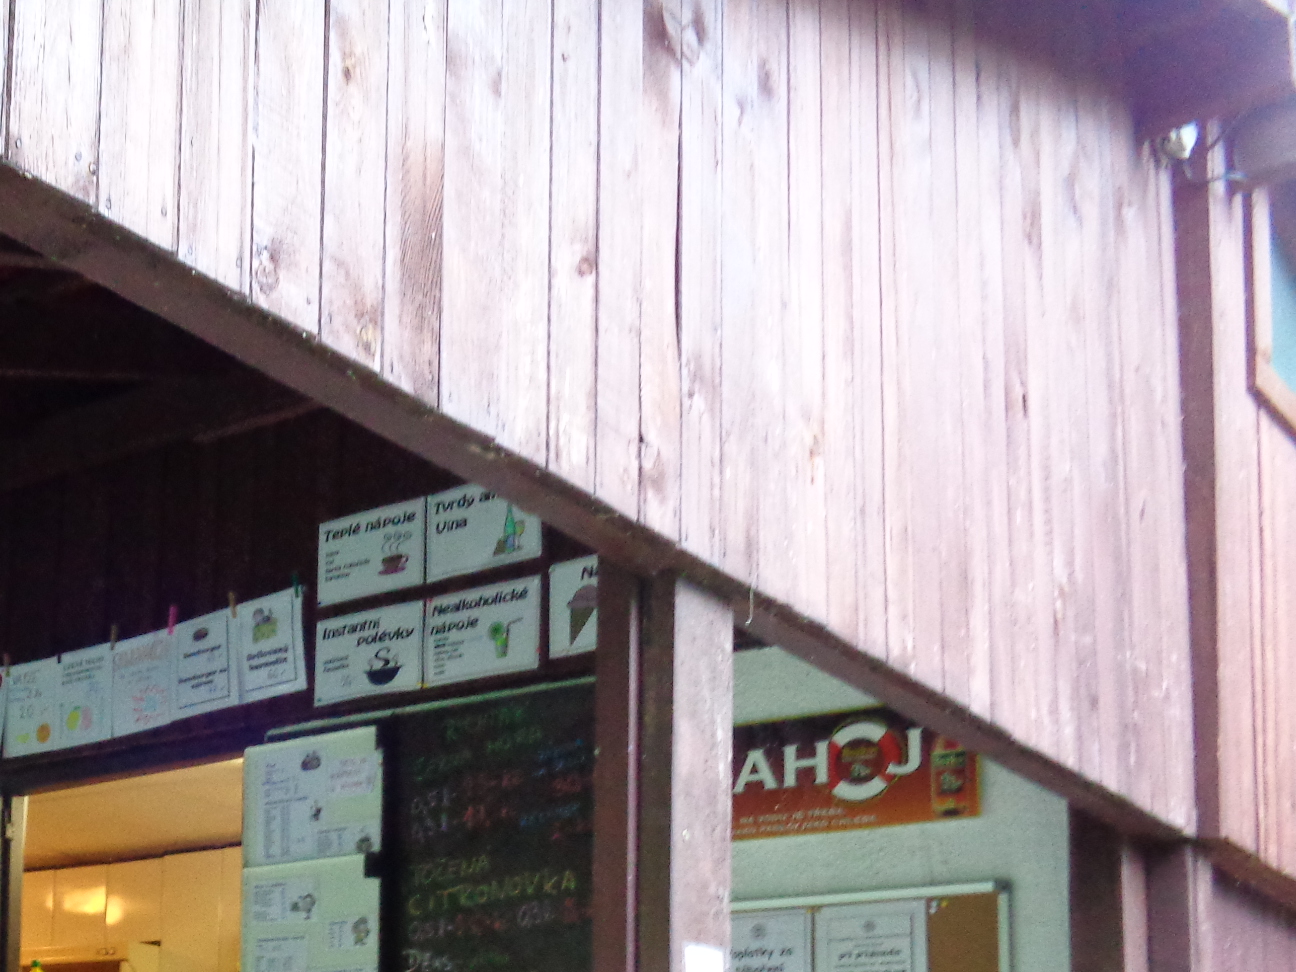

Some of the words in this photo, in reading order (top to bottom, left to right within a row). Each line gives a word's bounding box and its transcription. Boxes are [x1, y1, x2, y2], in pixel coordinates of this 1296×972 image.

[324, 522, 361, 543] Teplé
[364, 511, 417, 533] nápoje
[432, 587, 529, 617] Nealkoholické
[322, 617, 382, 641] Instantní
[356, 627, 415, 648] polévky
[430, 616, 480, 636] nápoje
[732, 719, 924, 801] AHOJ
